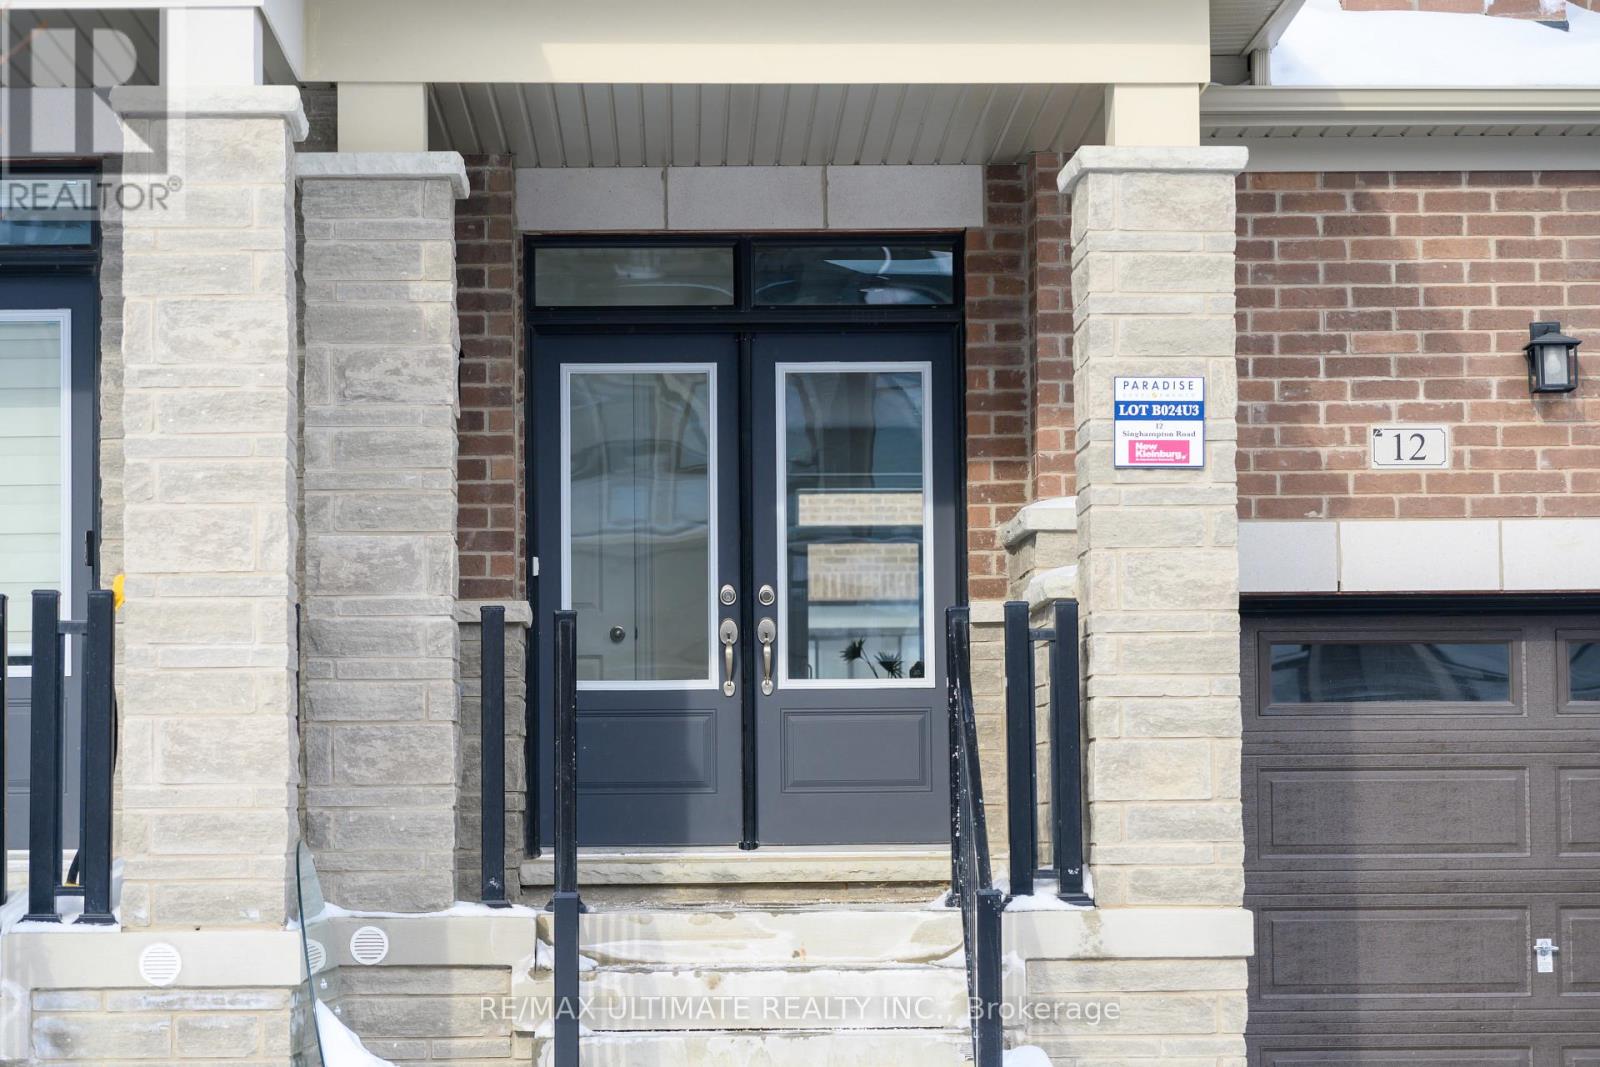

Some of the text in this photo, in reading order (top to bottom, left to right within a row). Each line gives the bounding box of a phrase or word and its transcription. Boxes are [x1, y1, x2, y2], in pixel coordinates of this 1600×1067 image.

[1123, 380, 1194, 390] PARADISE
[1118, 404, 1199, 416] LOT B024U3
[1135, 442, 1158, 450] New
[1393, 433, 1427, 460] 12
